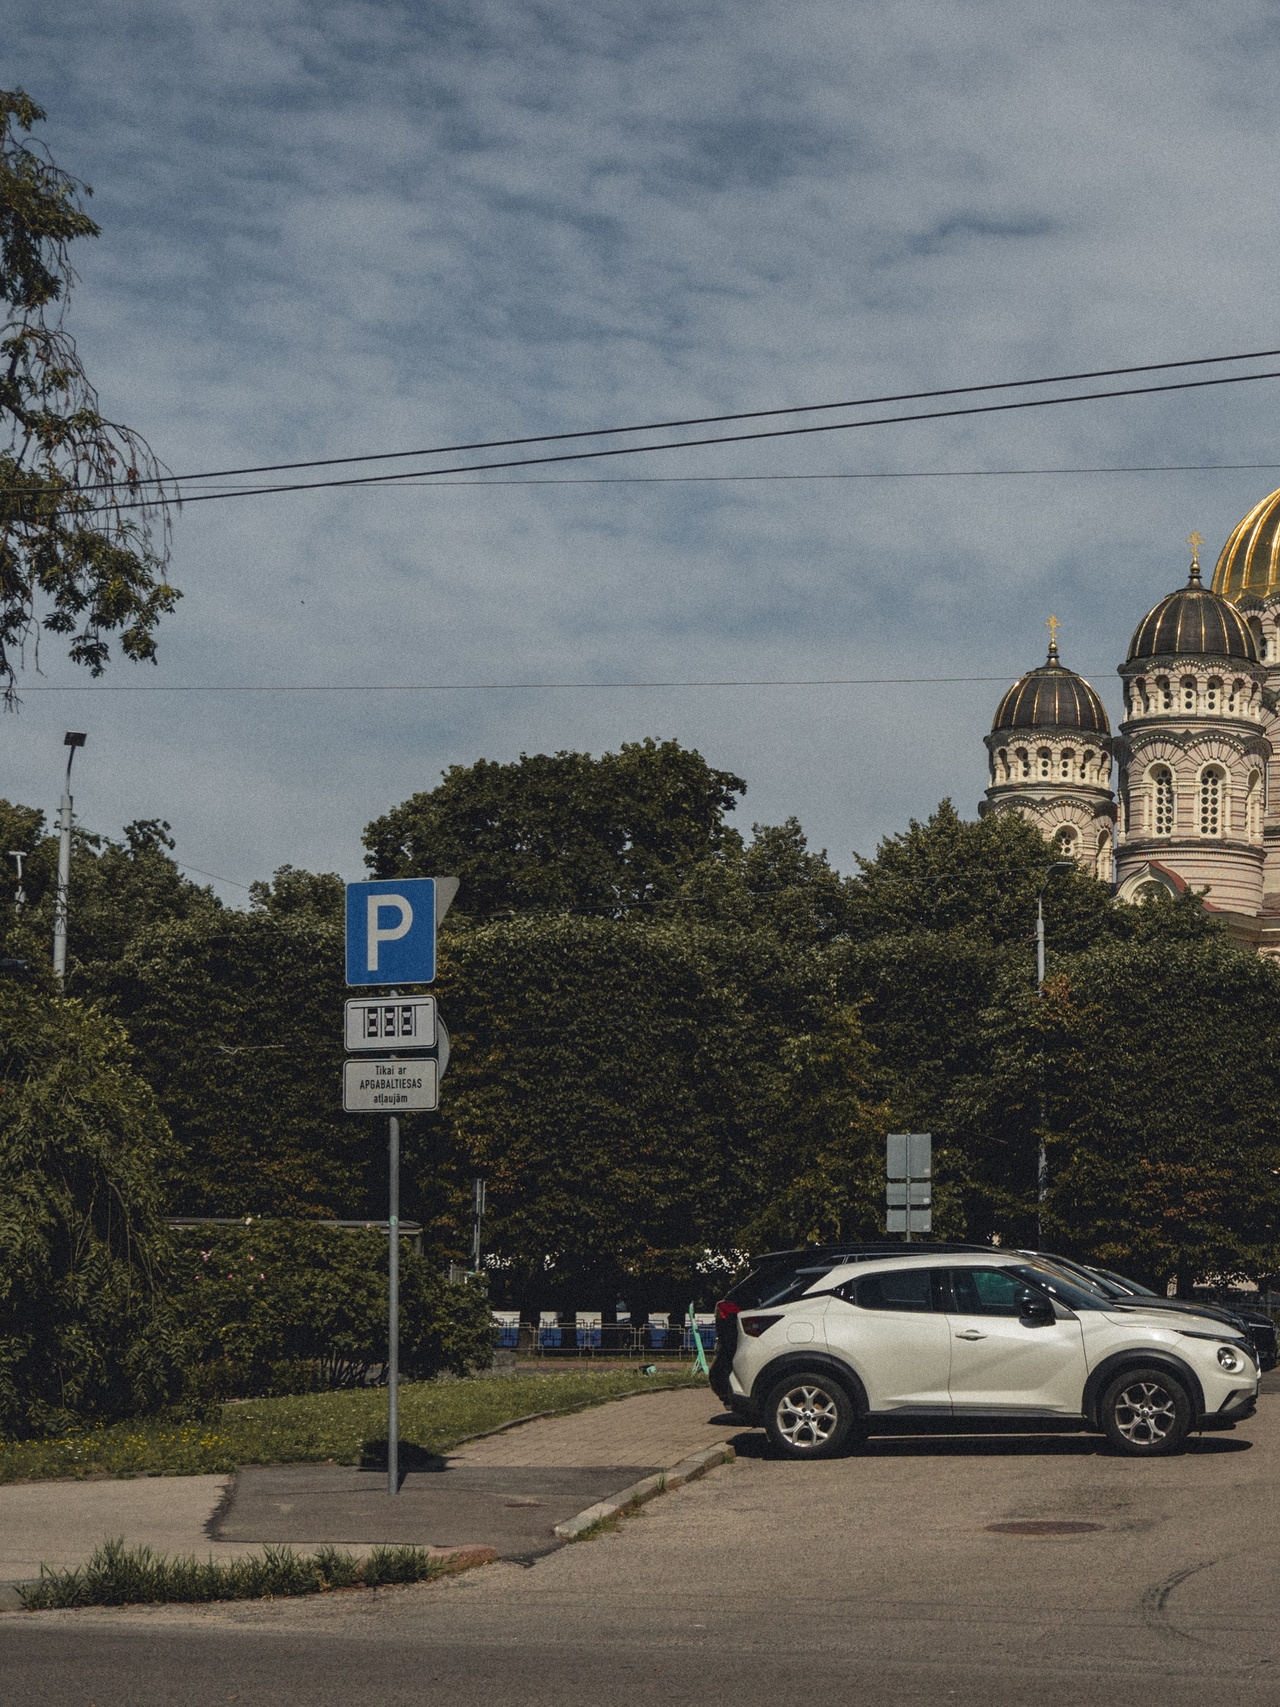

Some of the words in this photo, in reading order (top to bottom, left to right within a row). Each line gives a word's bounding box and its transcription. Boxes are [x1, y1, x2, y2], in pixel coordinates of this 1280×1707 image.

[367, 894, 413, 971] P
[375, 1065, 394, 1075] Tikai
[398, 1067, 407, 1075] ar
[360, 1079, 422, 1089] APGABALTIESAS
[374, 1093, 408, 1105] atļaujām
